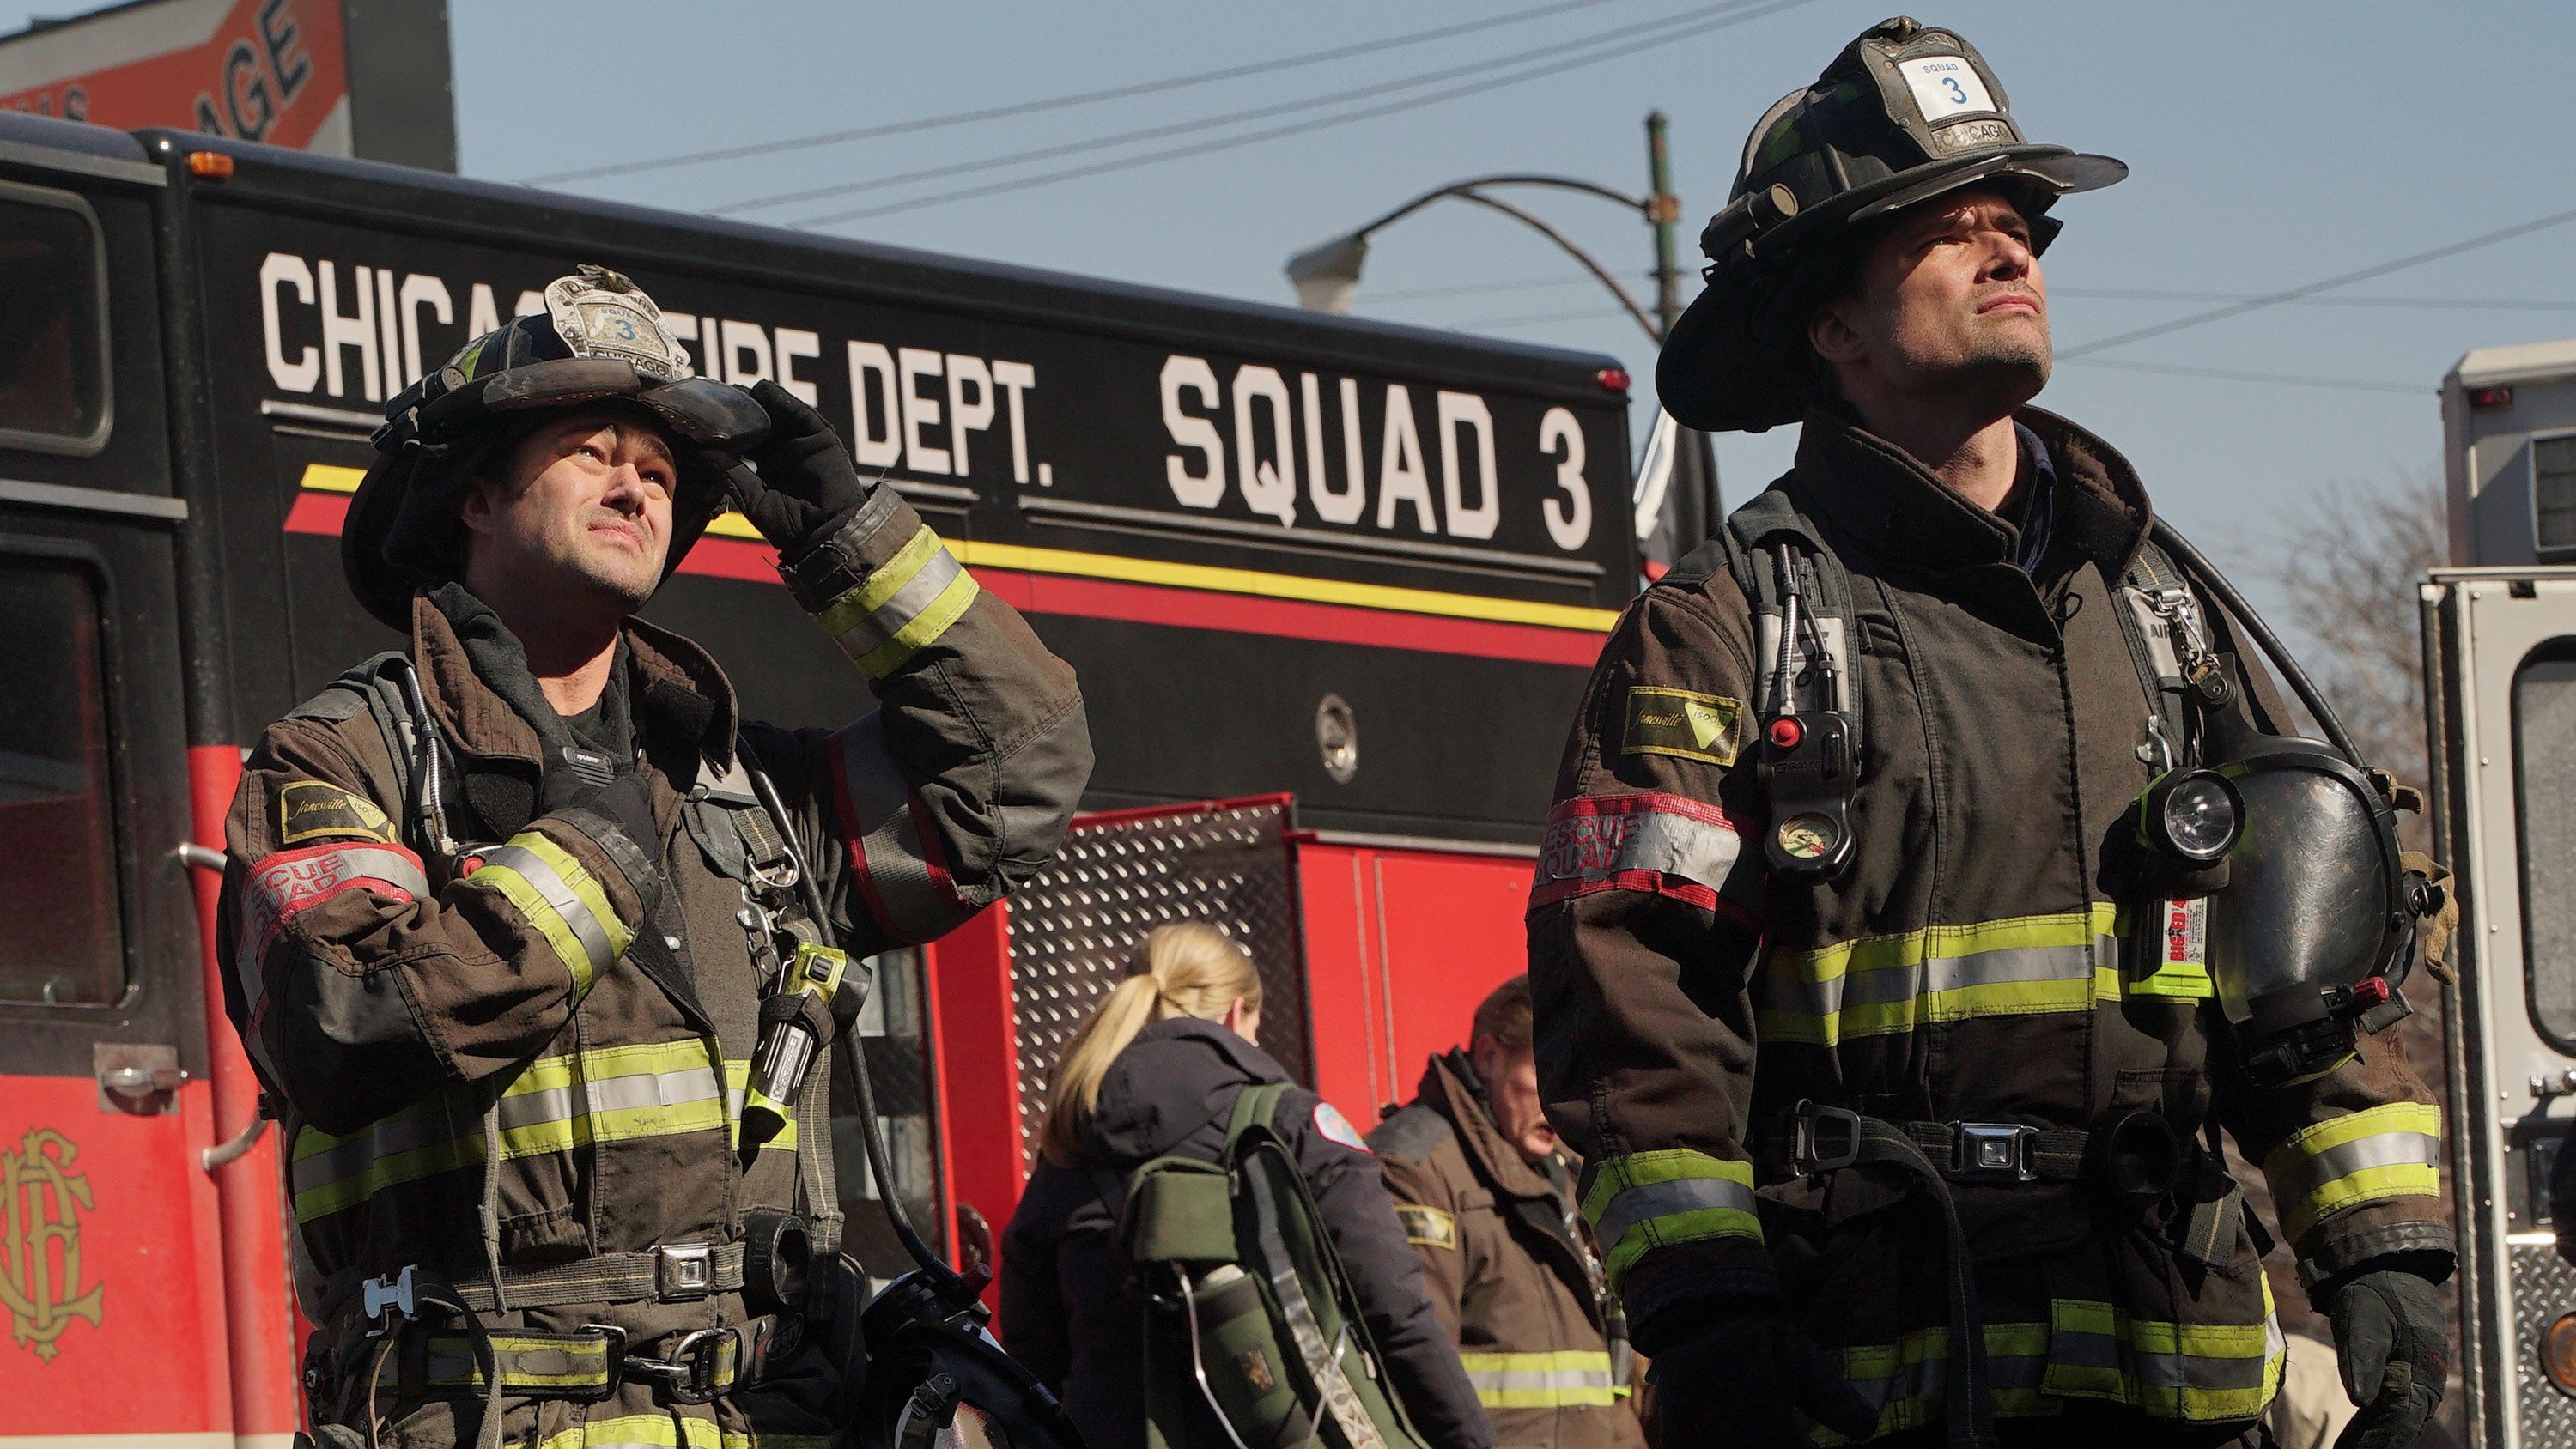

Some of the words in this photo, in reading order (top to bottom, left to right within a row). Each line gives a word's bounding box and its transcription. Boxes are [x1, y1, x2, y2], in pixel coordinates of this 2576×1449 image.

[1923, 63, 1959, 74] SQUAD
[1942, 76, 1968, 105] 3
[1941, 124, 2009, 146] CHICAGO
[615, 319, 636, 341] 3
[260, 252, 546, 403] CHIC
[847, 339, 1053, 488] DEPT.
[1159, 354, 1500, 541] SQUAD
[1539, 407, 1593, 551] 3
